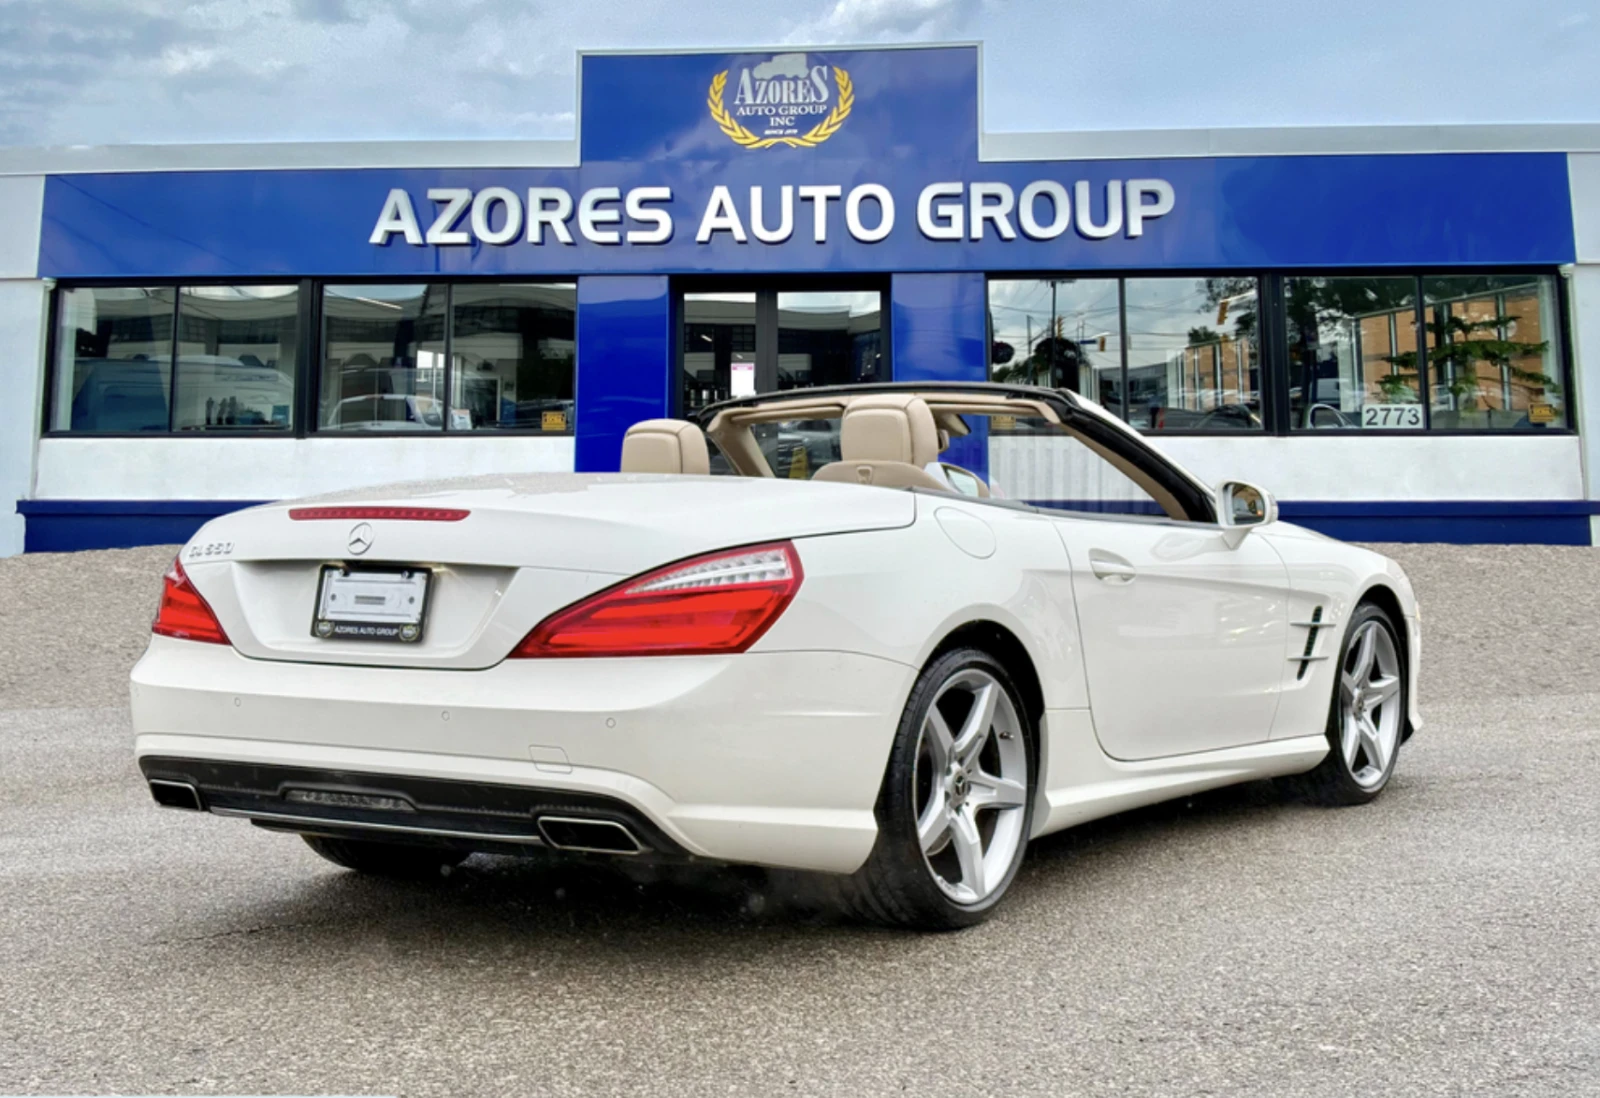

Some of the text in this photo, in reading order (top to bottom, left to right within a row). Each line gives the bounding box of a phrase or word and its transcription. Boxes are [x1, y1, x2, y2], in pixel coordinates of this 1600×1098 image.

[733, 65, 829, 105] AZORES
[736, 104, 827, 116] AUTO GROUP
[770, 116, 795, 126] INC
[368, 178, 1175, 246] AZORES AUTO GROUP
[1365, 407, 1420, 426] 2773
[359, 626, 376, 635] AUTO
[376, 627, 399, 637] GROUP
